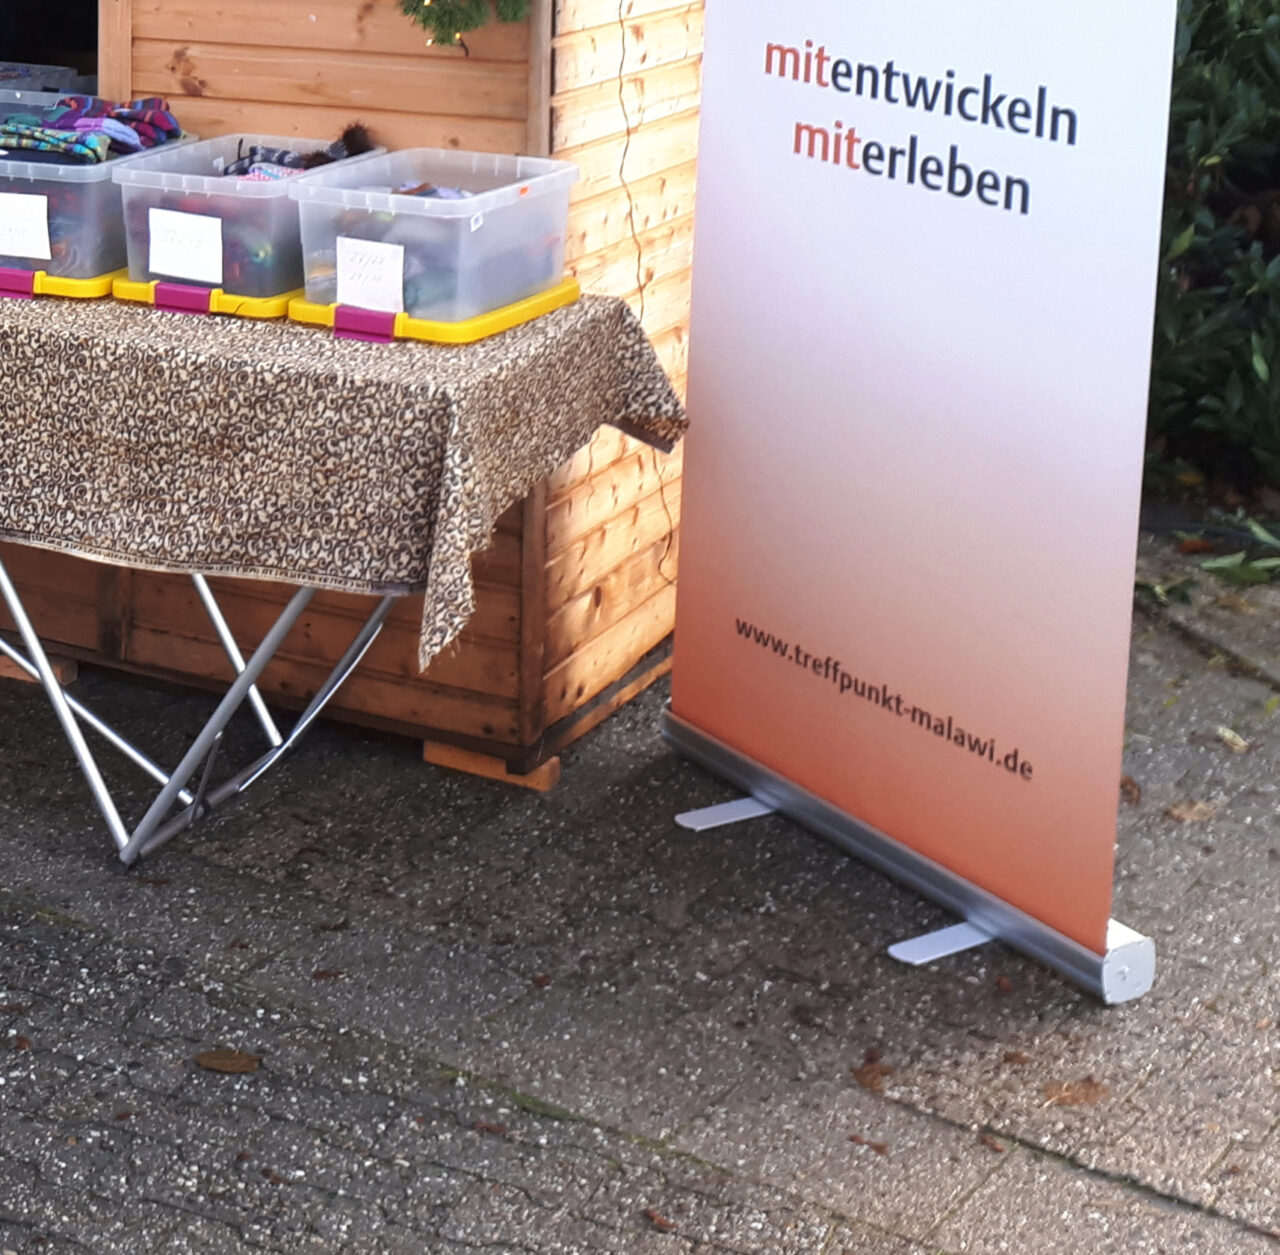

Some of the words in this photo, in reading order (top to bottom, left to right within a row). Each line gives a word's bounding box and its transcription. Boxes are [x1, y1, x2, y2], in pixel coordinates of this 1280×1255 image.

[764, 38, 1078, 146] mitentwickeln
[793, 119, 1030, 216] miterleben
[735, 617, 1034, 781] www.treffpunkt-malawi.de
